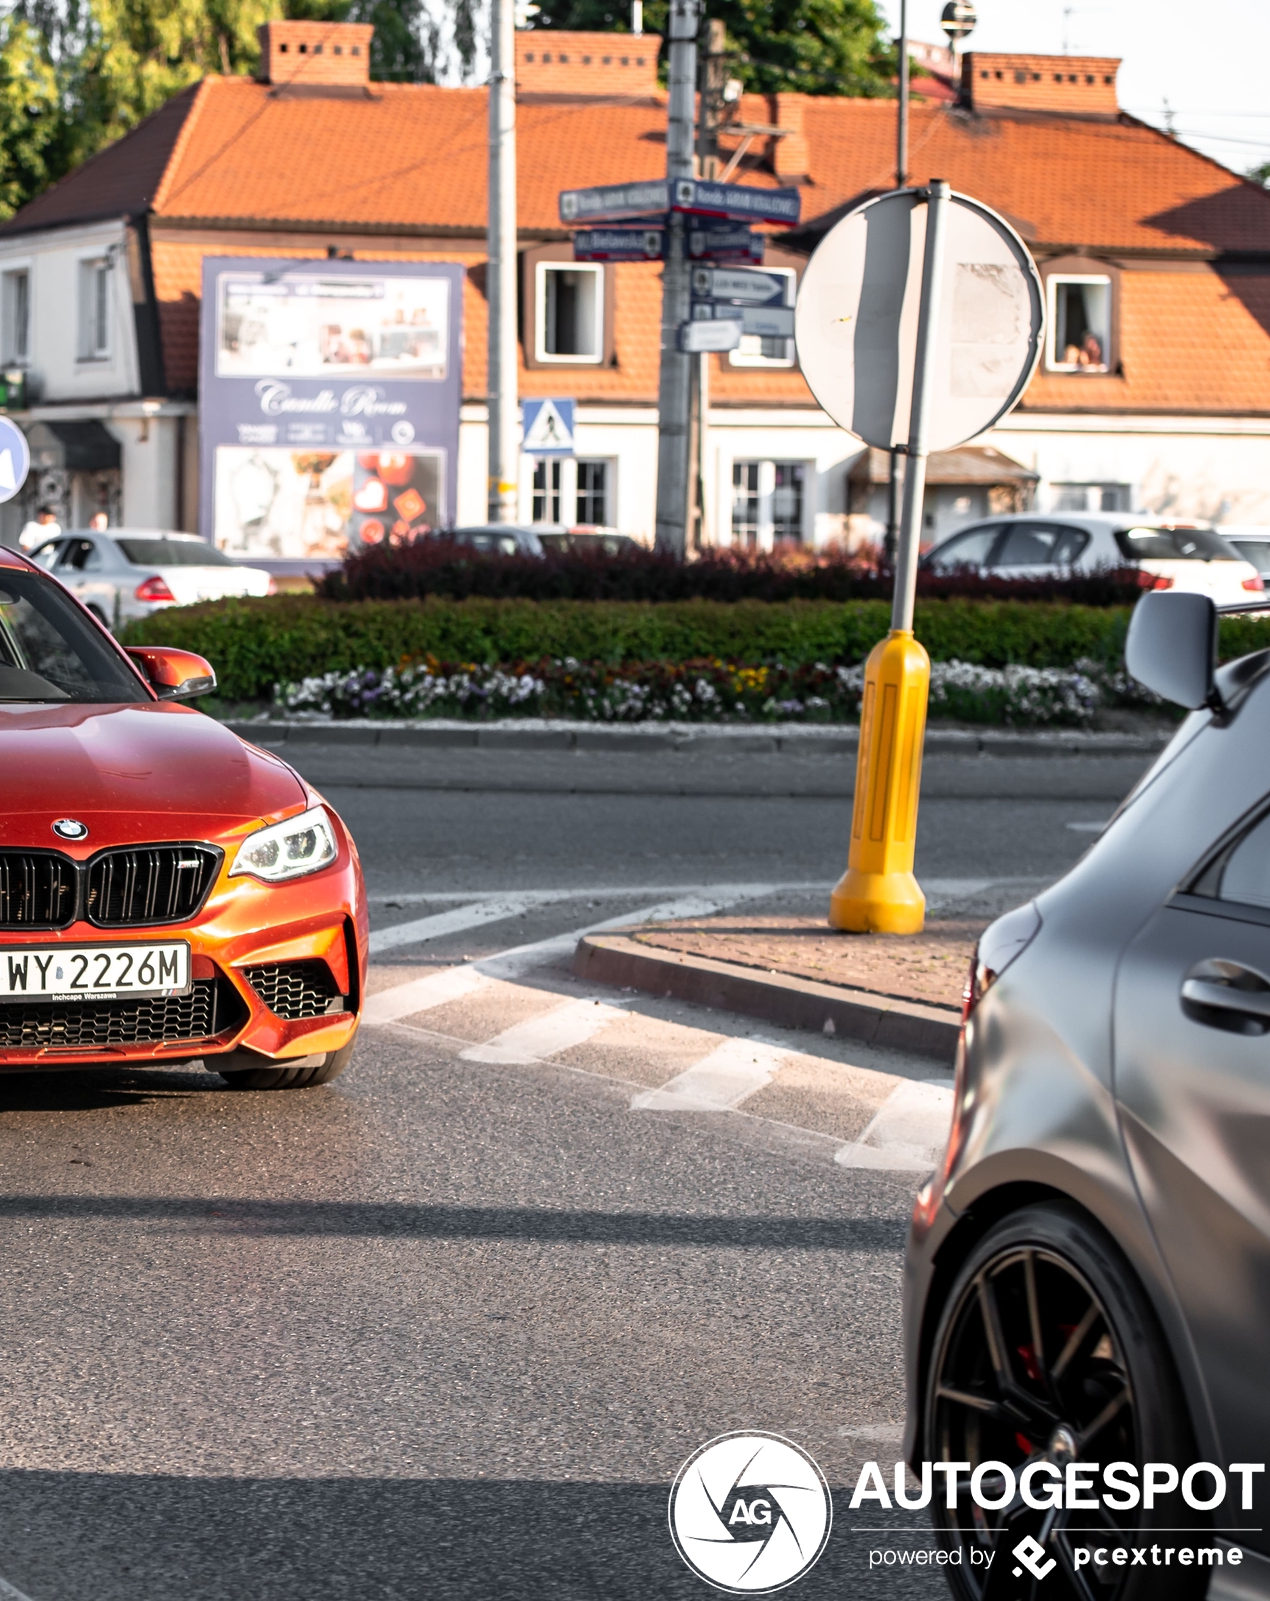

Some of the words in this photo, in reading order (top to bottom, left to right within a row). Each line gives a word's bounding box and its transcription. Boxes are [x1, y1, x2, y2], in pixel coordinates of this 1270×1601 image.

[7, 955, 54, 991] WY
[70, 950, 178, 989] 2226M
[52, 993, 82, 1001] Inchcape
[84, 992, 117, 1000] Warszawa
